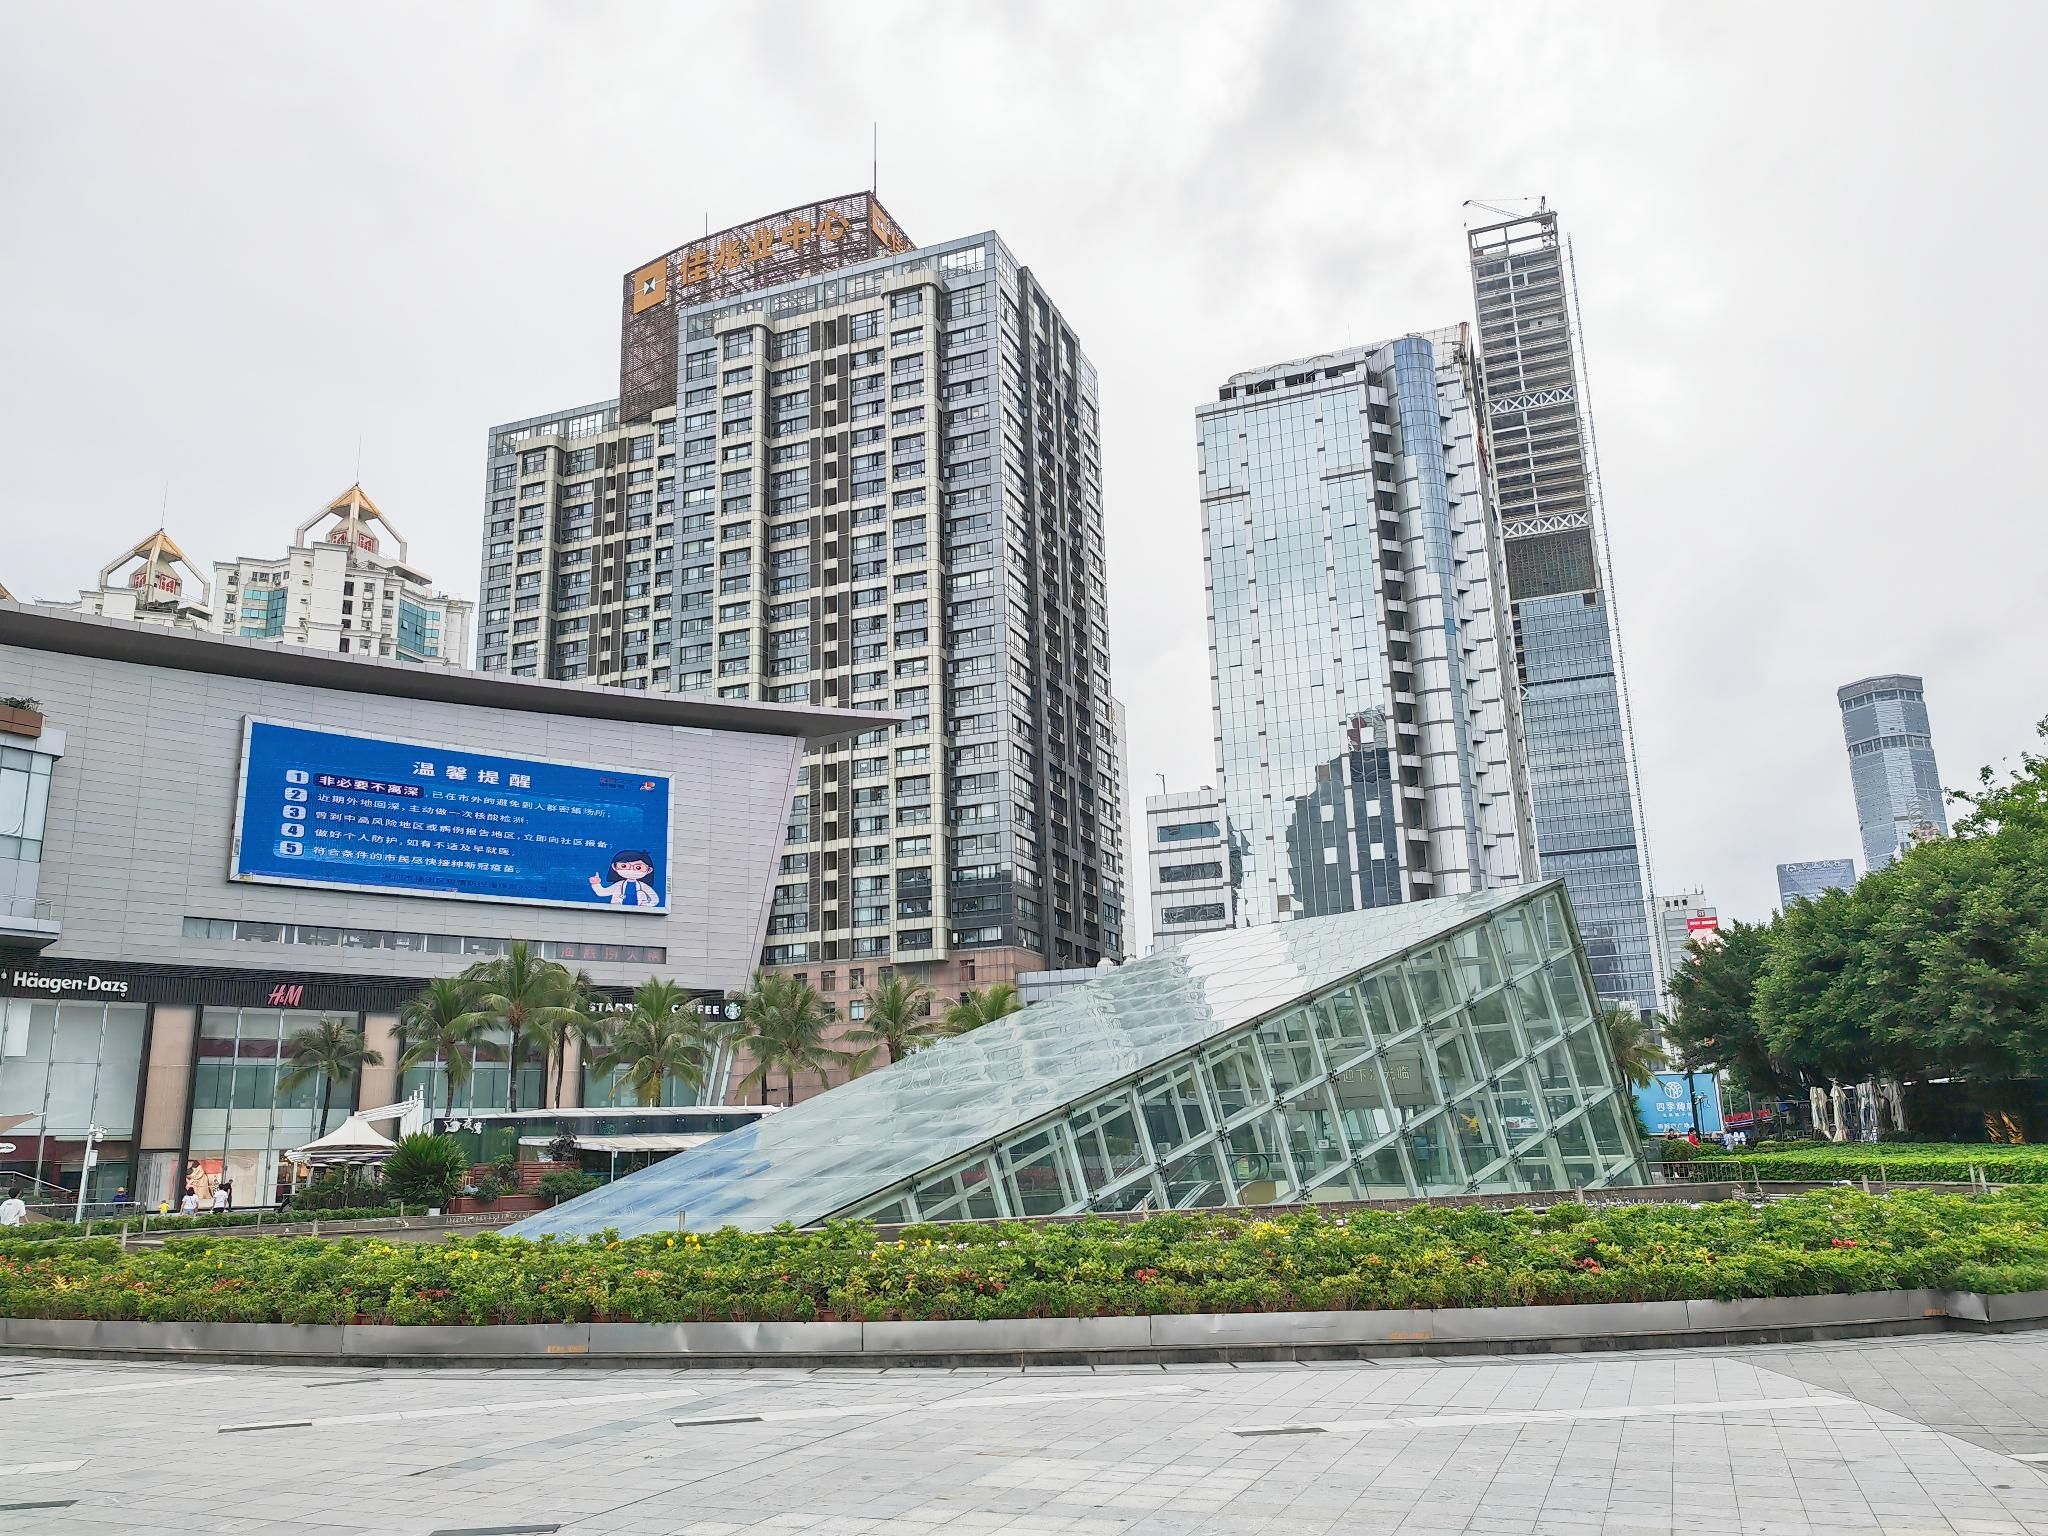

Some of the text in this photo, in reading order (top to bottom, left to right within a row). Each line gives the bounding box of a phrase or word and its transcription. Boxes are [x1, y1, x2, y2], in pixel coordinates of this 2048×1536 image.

[679, 209, 850, 286] 佳兆业中心
[412, 761, 532, 789] 温馨提醒
[12, 971, 129, 998] Häagen-Dazs
[267, 984, 304, 1006] H&M
[671, 1004, 720, 1014] CFEE
